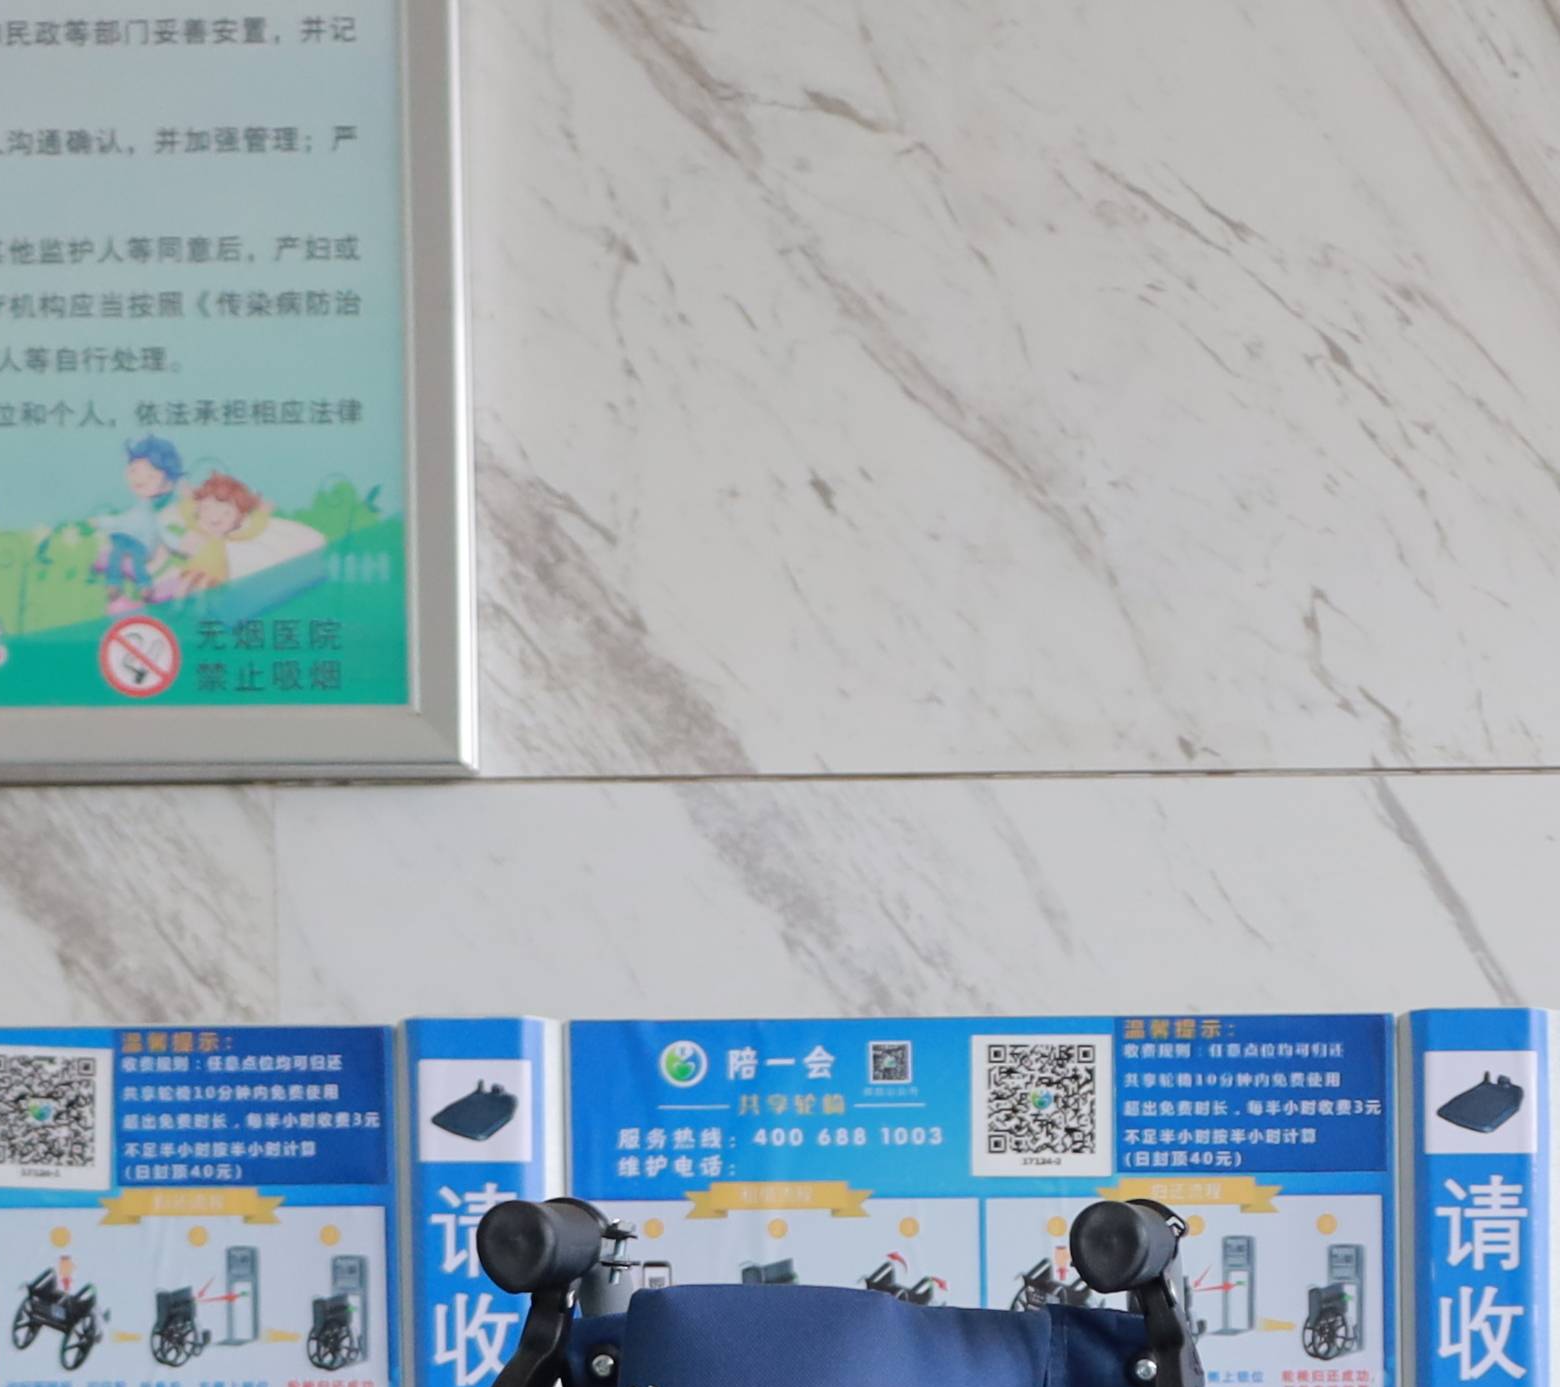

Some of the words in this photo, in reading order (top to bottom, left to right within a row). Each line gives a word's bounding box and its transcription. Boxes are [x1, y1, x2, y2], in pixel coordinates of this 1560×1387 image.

[196, 618, 343, 650] 无烟医院
[196, 660, 343, 693] 禁止吸烟
[726, 1044, 836, 1081] 陪一会
[616, 1127, 738, 1150] 服务热线：
[753, 1126, 804, 1147] 400
[817, 1126, 868, 1147] 688
[880, 1126, 944, 1147] 1003
[616, 1154, 738, 1178] 维护电话：
